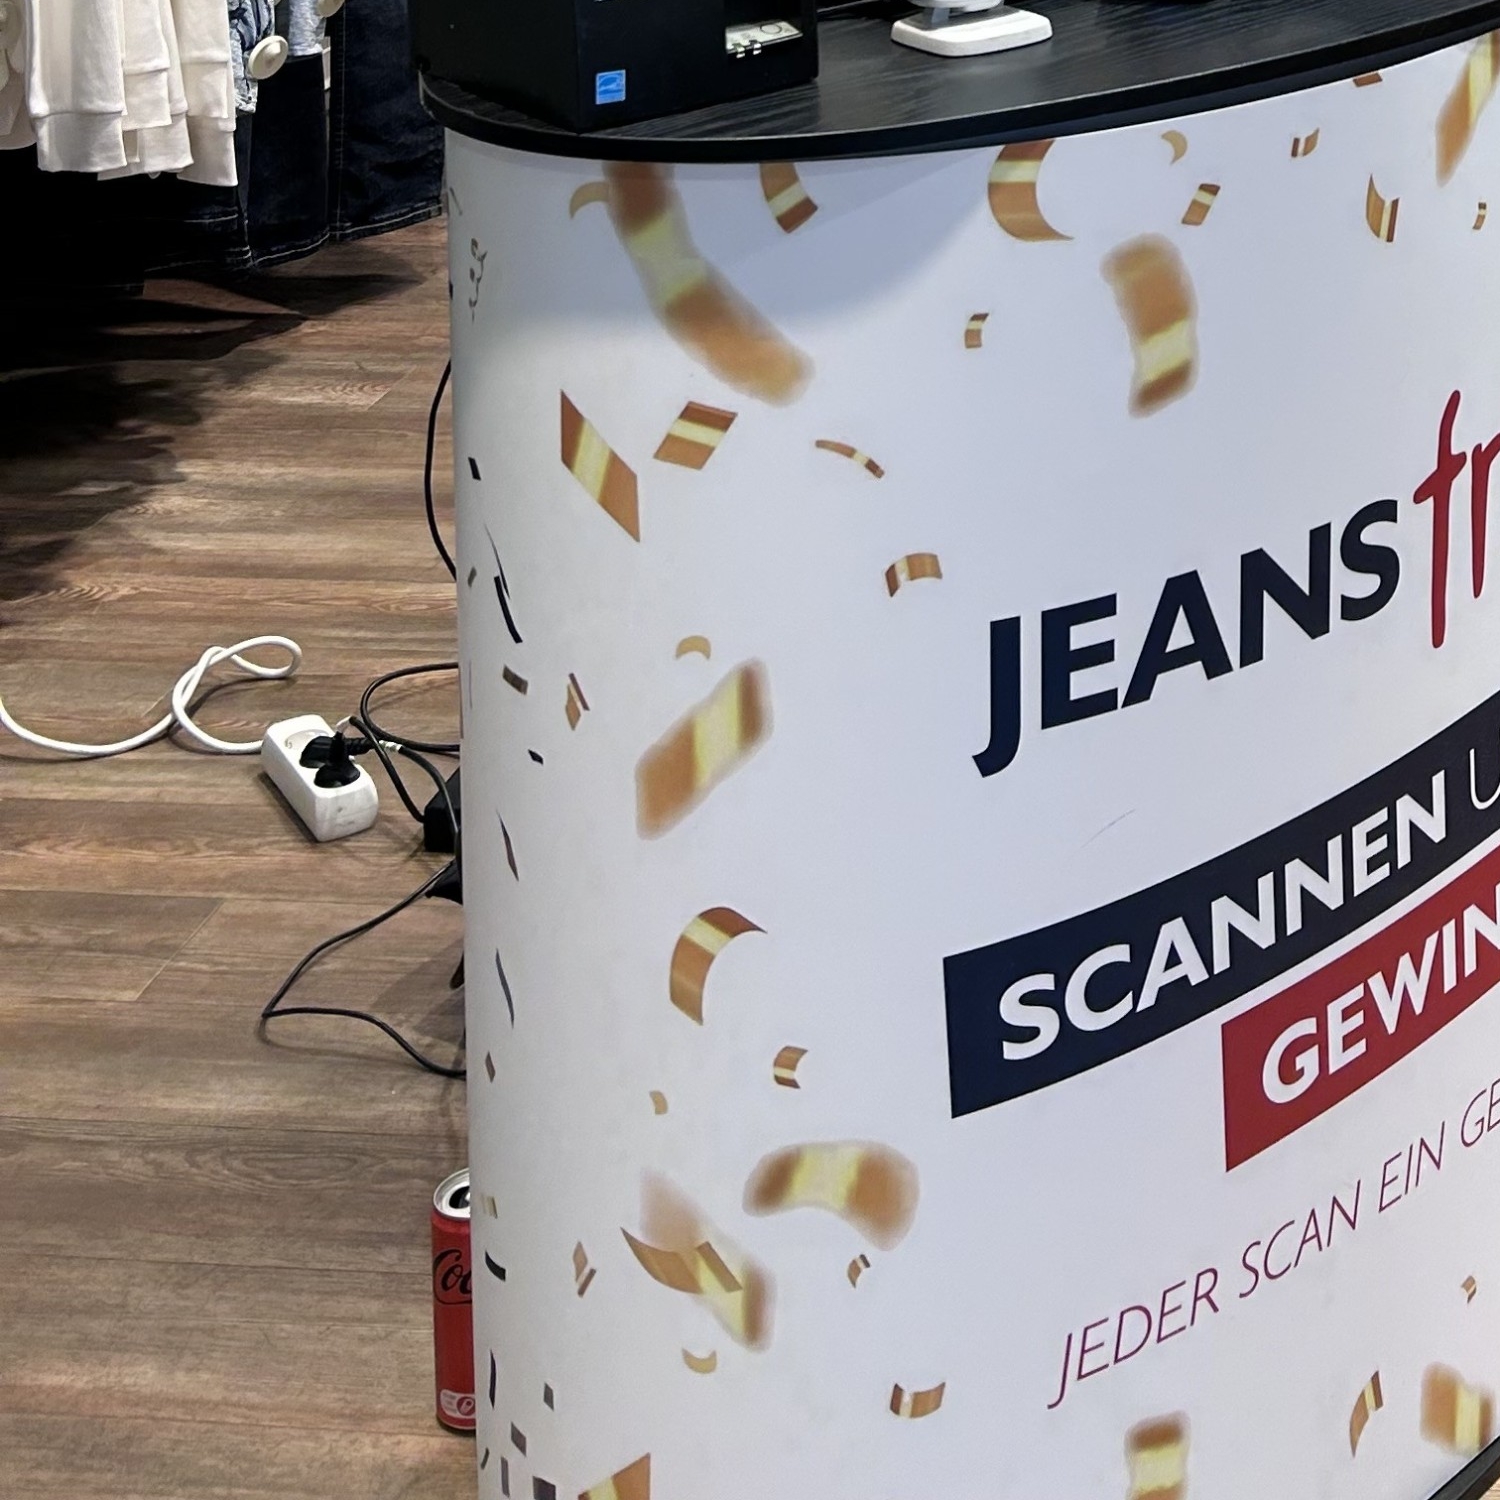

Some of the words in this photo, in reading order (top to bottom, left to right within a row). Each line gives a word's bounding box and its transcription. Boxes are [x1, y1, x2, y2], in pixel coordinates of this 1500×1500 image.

[972, 498, 1400, 778] JEANS
[998, 769, 1447, 1061] SCANNEN
[1046, 1267, 1220, 1409] JEDER
[1238, 1179, 1361, 1299] SCAN
[1378, 1121, 1445, 1213] EIN
